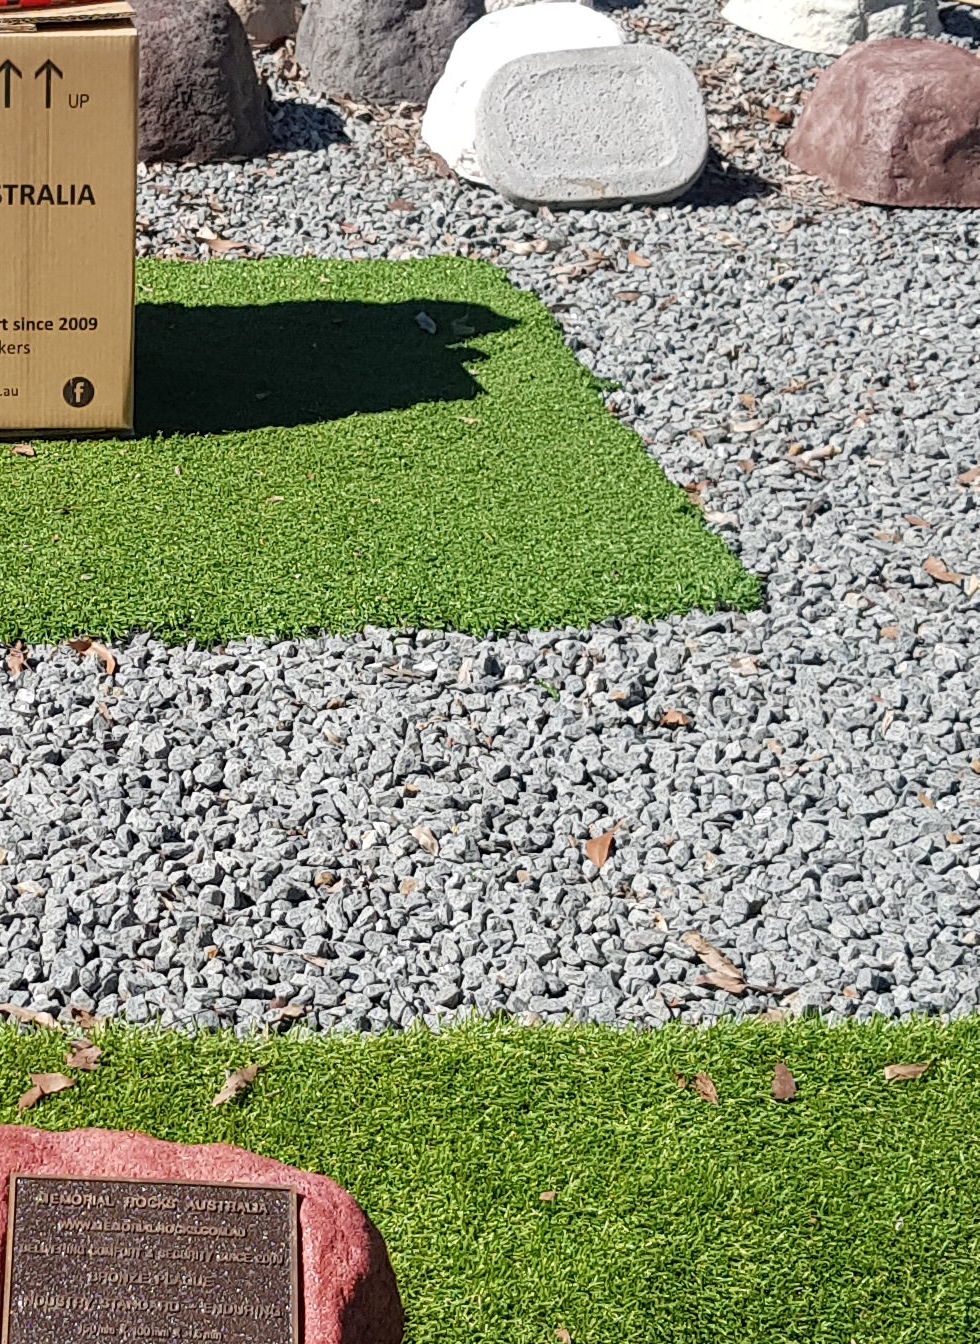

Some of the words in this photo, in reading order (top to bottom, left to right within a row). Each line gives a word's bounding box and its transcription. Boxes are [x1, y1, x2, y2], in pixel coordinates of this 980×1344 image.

[68, 93, 90, 109] UP
[12, 316, 54, 332] since
[58, 316, 98, 331] 2009
[38, 1193, 116, 1208] MEMORIAL
[124, 1195, 178, 1210] ROCKS
[187, 1198, 270, 1215] AUSTRALIA
[89, 1271, 151, 1287] BRONZE
[204, 1301, 284, 1319] ENDURING
